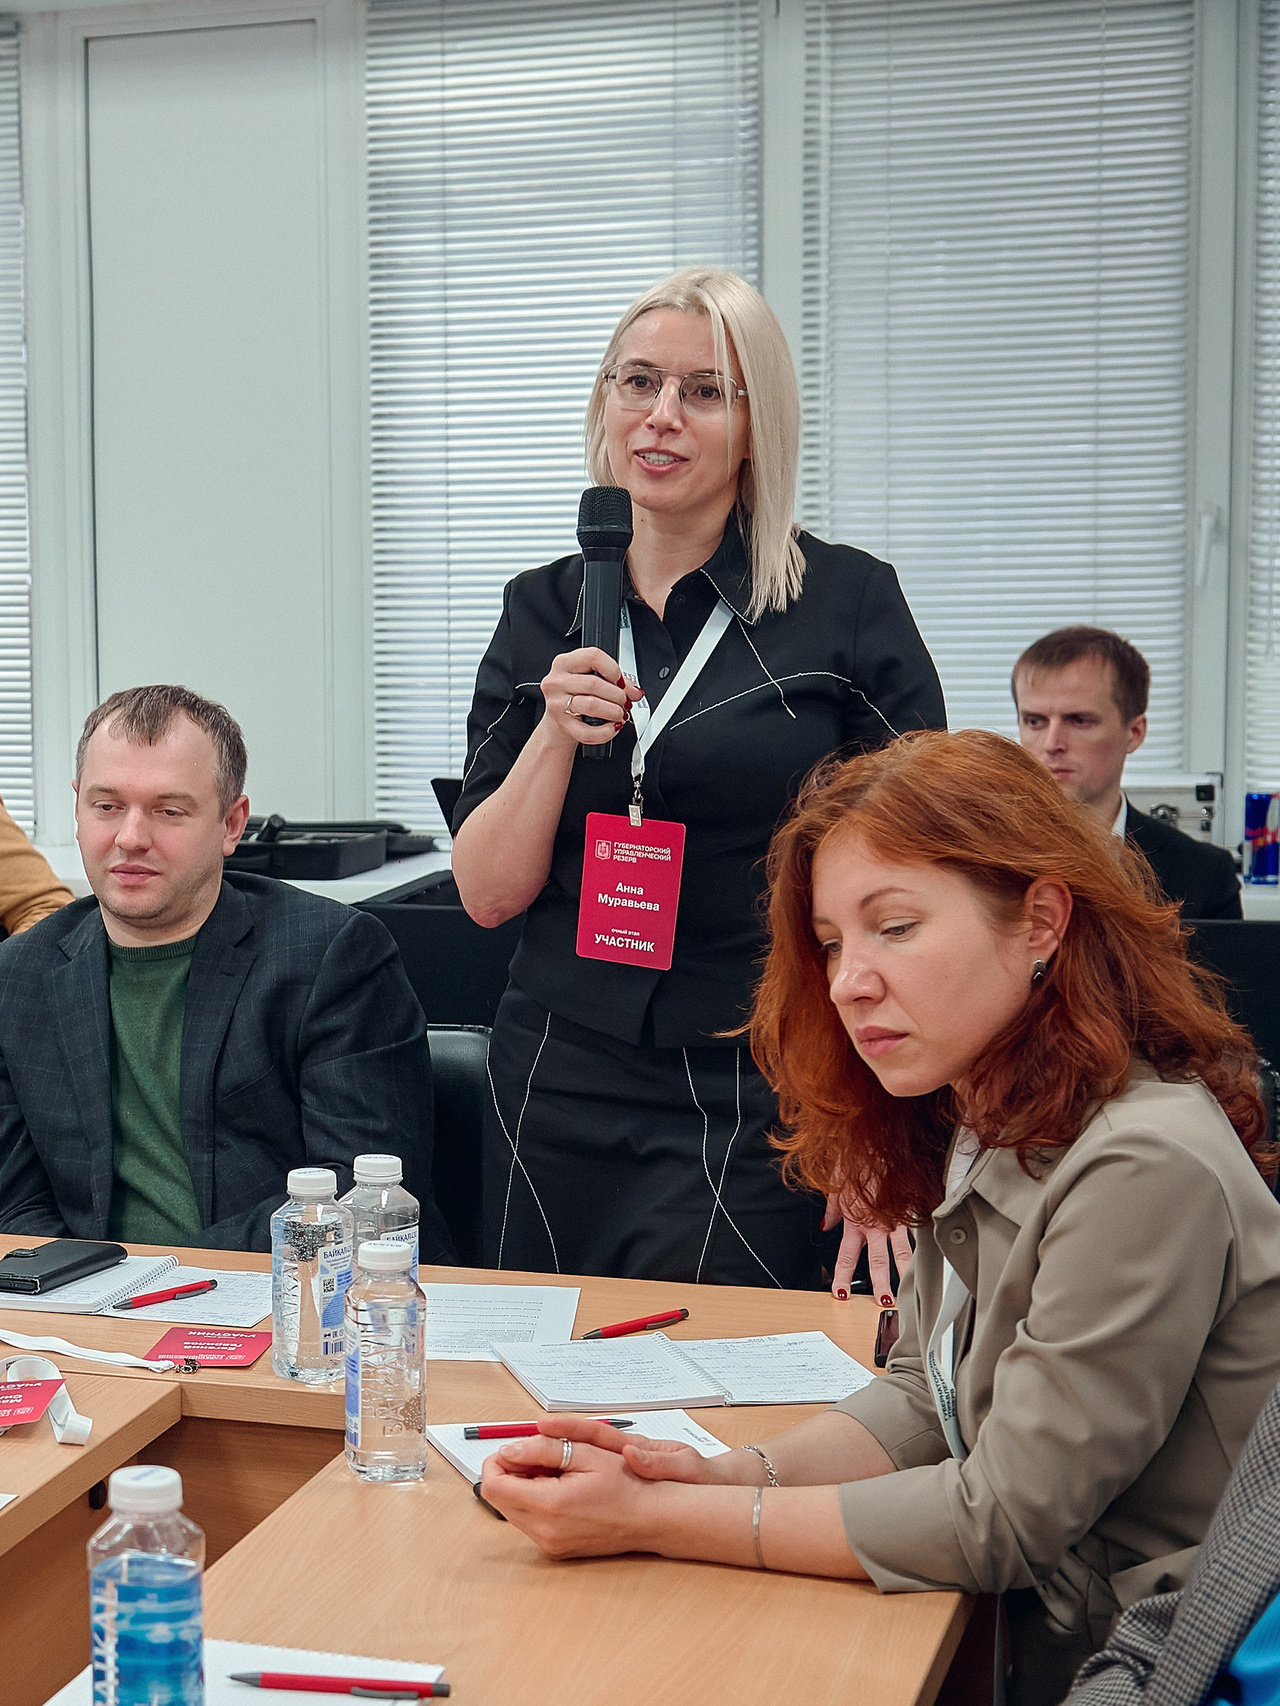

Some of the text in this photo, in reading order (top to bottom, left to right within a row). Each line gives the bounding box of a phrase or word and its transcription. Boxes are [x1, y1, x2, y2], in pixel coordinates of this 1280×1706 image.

[613, 842, 671, 855] ГУБЕРНАТОРСКИЙ
[613, 849, 672, 861] УПРАВЛЕНЧЕСКИЙ
[612, 855, 637, 863] РЕЗЕРВ
[615, 882, 644, 895] Анна
[597, 893, 660, 911] Муравьева
[594, 934, 655, 952] УЧАСТНИК
